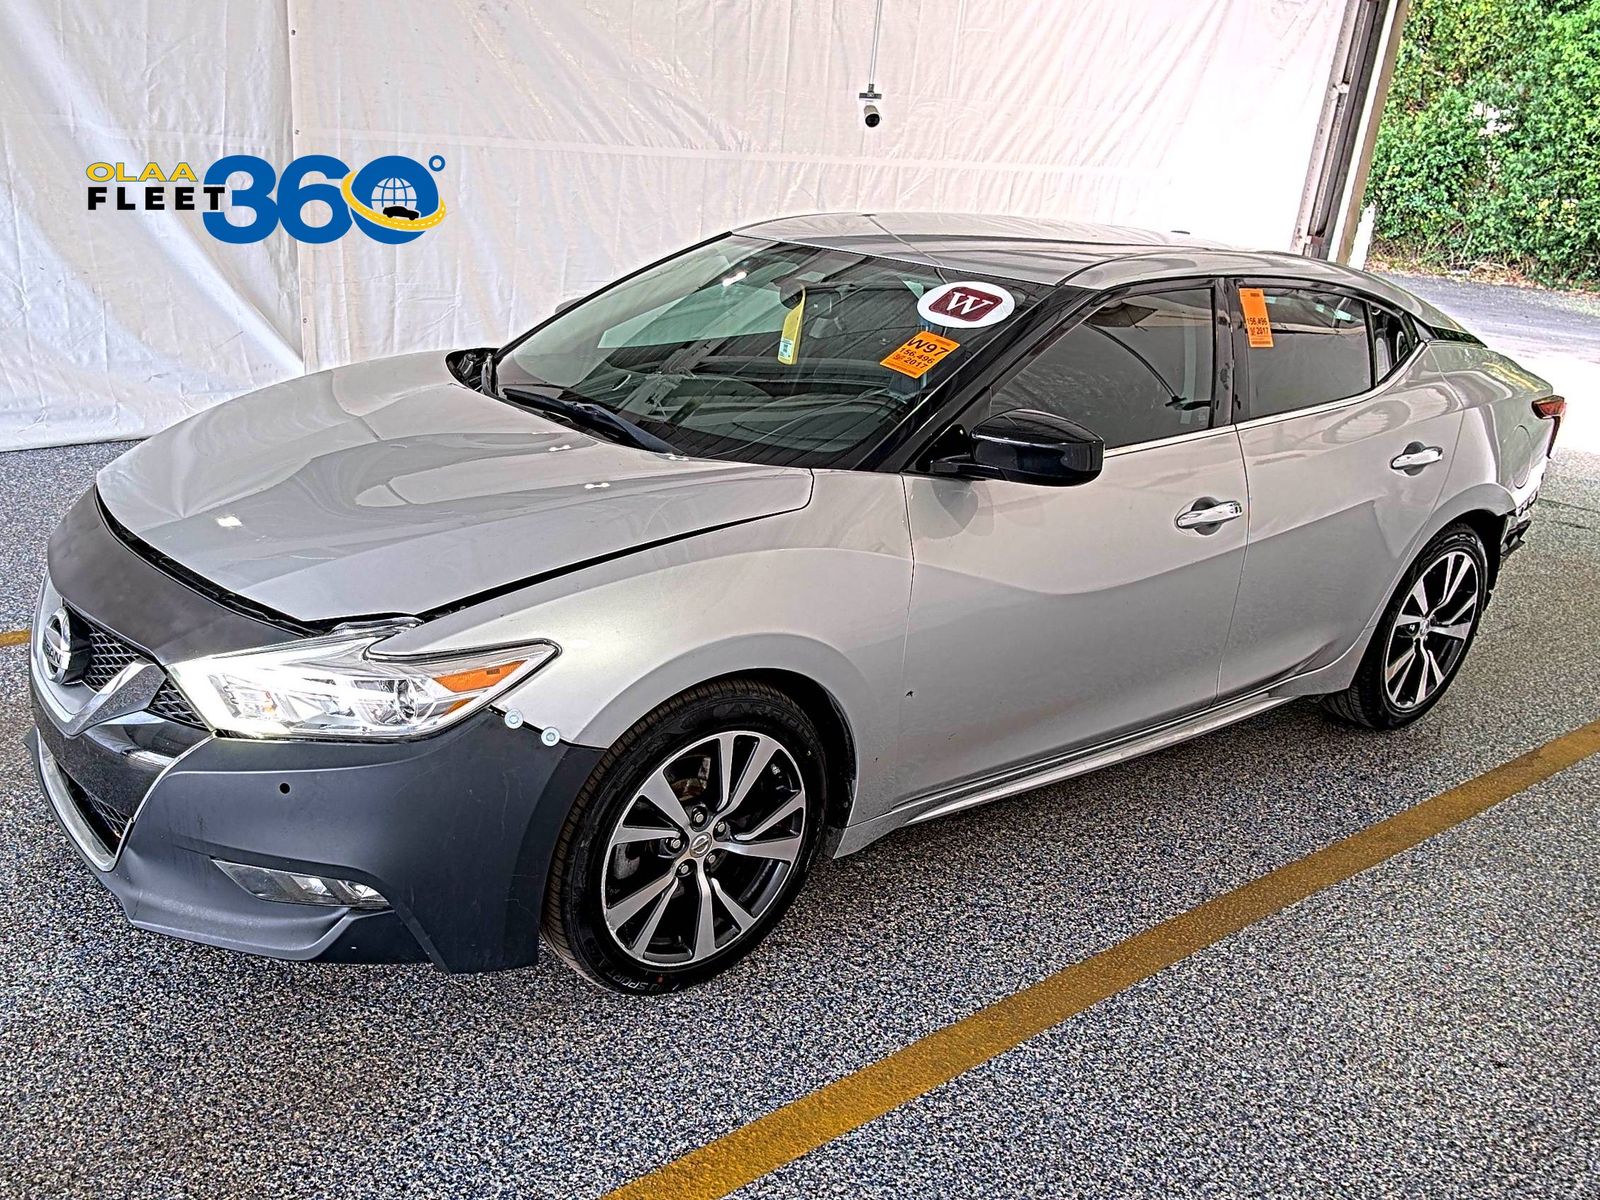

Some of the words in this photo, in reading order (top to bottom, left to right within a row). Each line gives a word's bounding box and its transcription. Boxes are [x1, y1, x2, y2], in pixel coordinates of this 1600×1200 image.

[949, 291, 994, 315] W
[907, 338, 950, 357] W97
[903, 357, 928, 369] 2017
